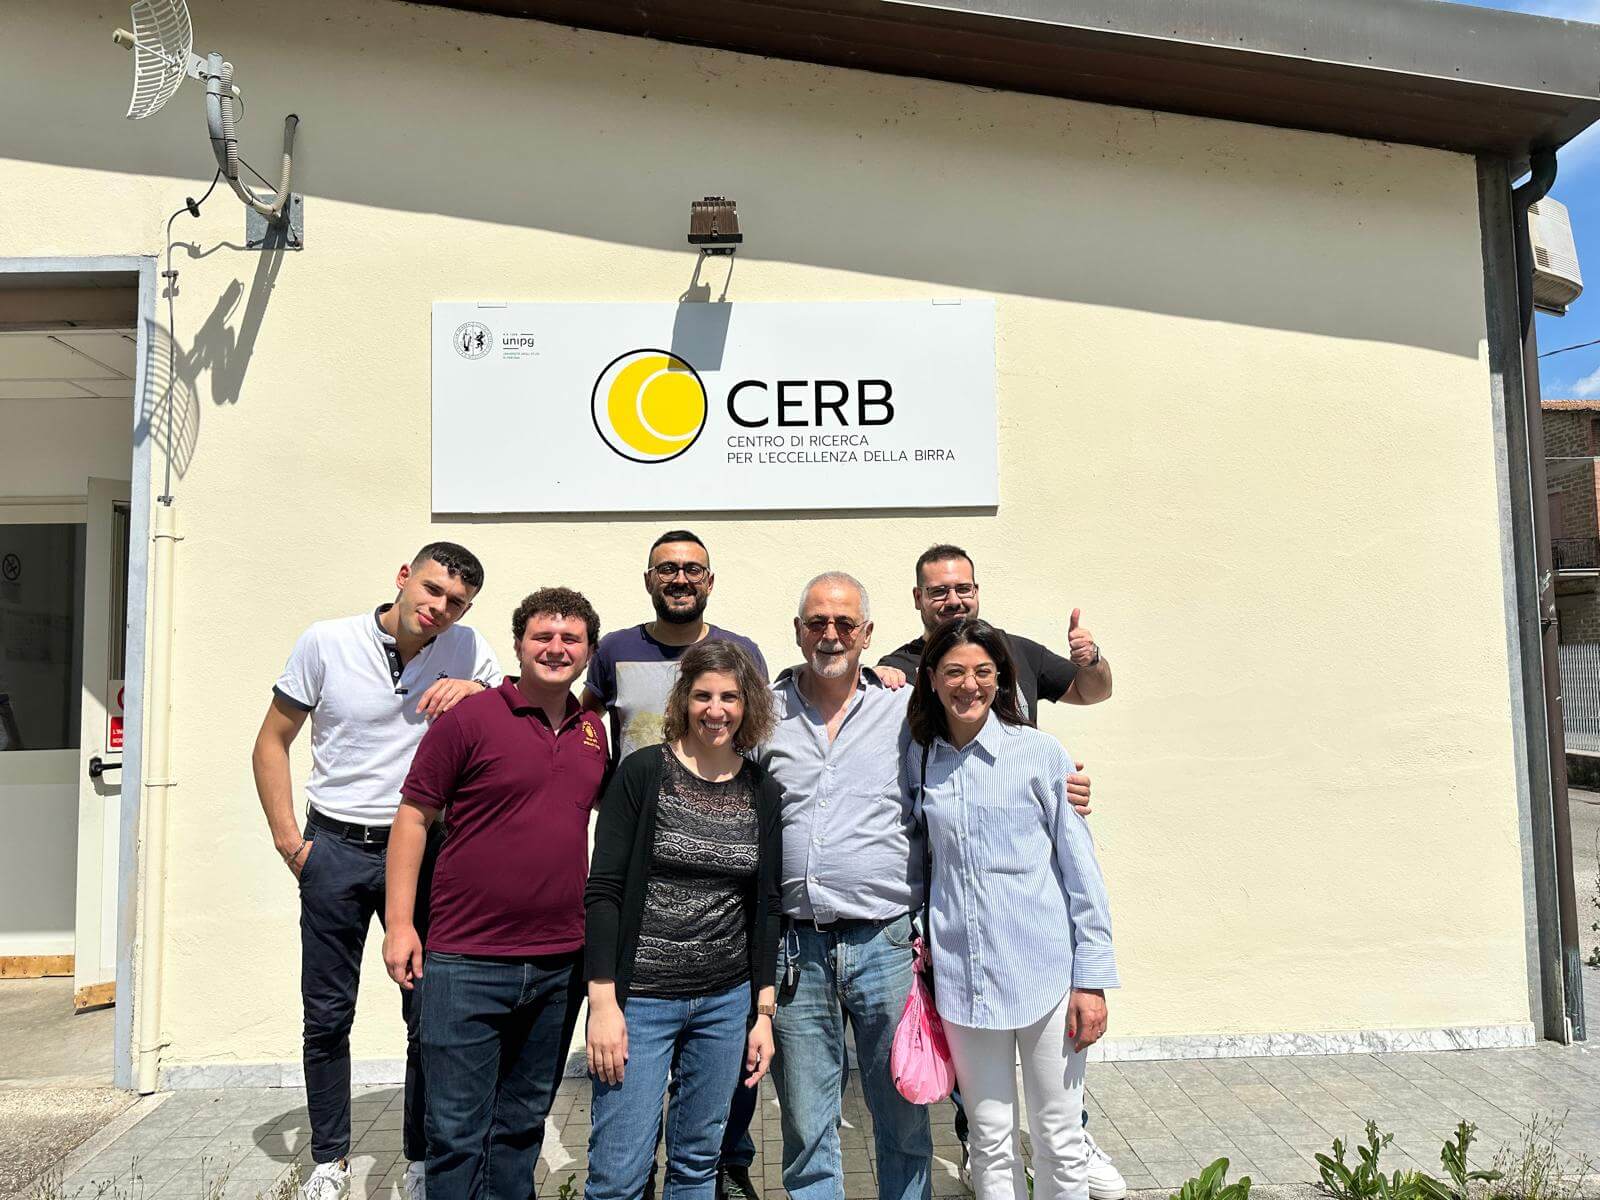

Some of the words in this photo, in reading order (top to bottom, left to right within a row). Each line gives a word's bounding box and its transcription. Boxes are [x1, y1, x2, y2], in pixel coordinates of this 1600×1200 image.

[502, 337, 534, 348] unipg
[726, 379, 895, 428] CERB
[727, 435, 785, 448] CENTRO
[790, 435, 804, 447] DI
[809, 434, 869, 447] RICERCA
[727, 452, 753, 464] PER
[758, 450, 858, 464] L'ECCELLENZA
[863, 450, 908, 462] DELLA
[914, 449, 955, 462] BIRRA
